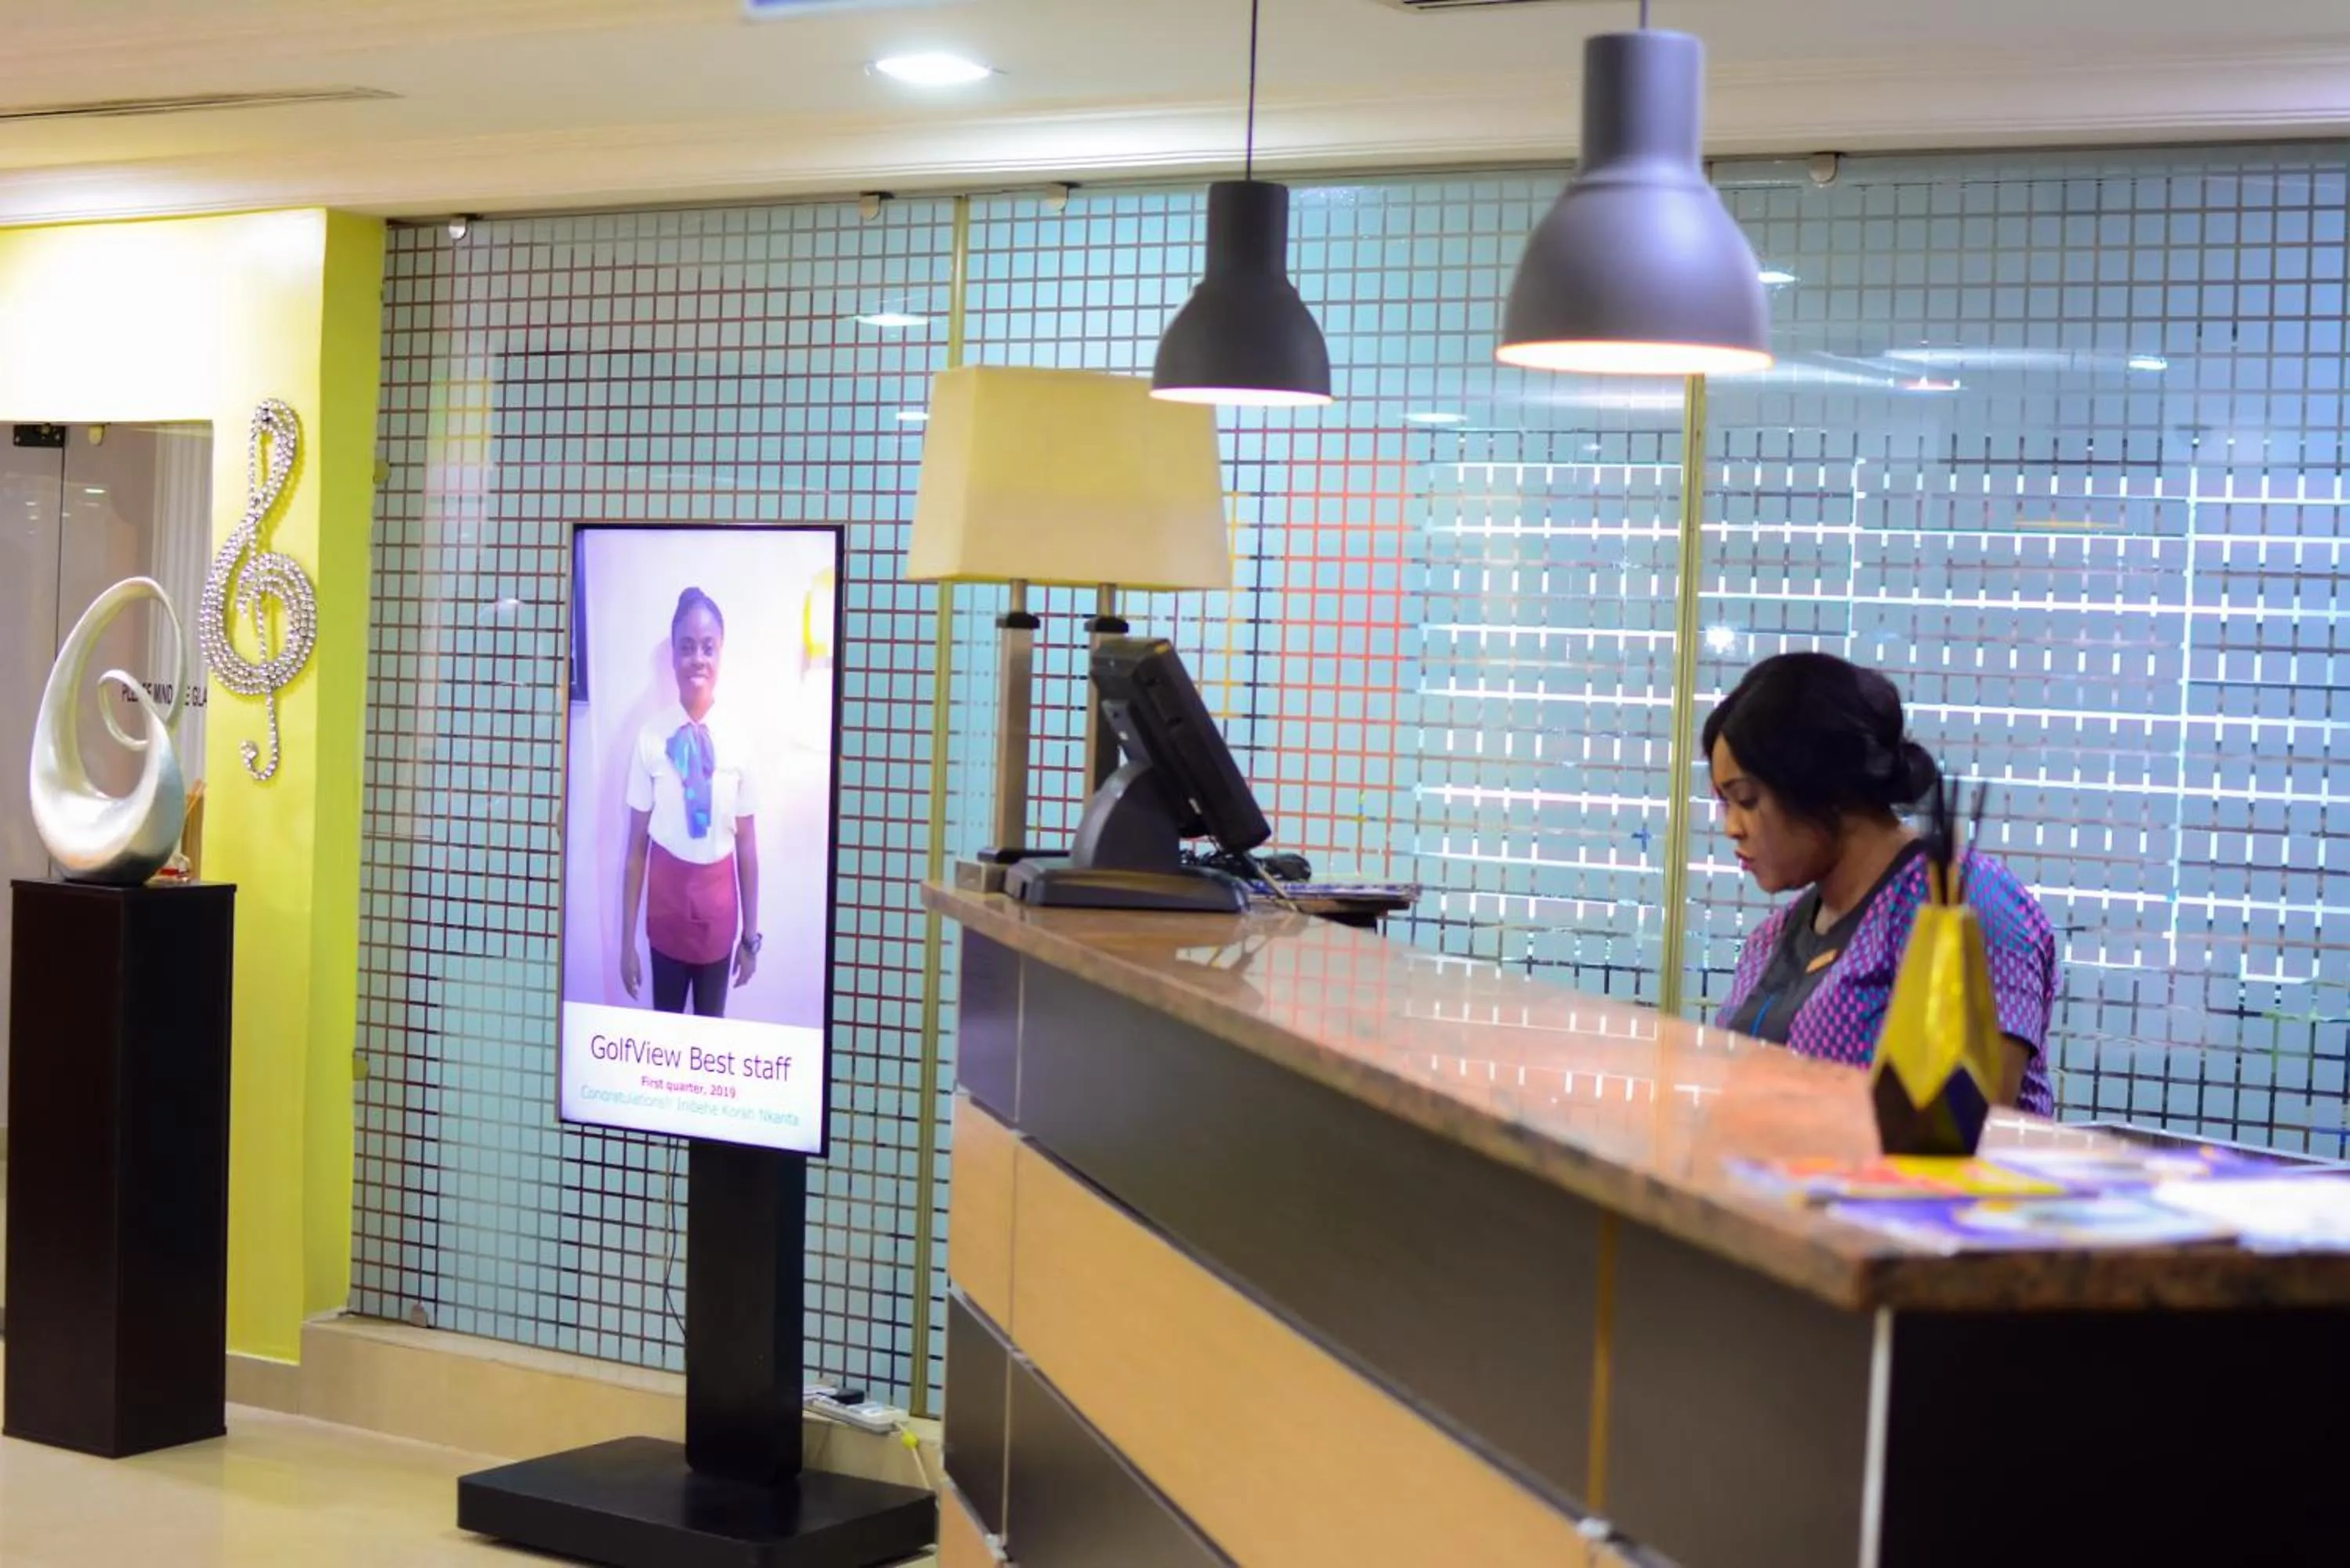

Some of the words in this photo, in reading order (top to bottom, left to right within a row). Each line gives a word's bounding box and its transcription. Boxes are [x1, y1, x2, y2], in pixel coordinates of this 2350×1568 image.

[153, 683, 173, 704] MIND
[591, 1035, 682, 1068] GolfView
[690, 1046, 736, 1076] Best
[743, 1057, 793, 1082] staff
[641, 1075, 663, 1089] First
[710, 1084, 736, 1099] 2019
